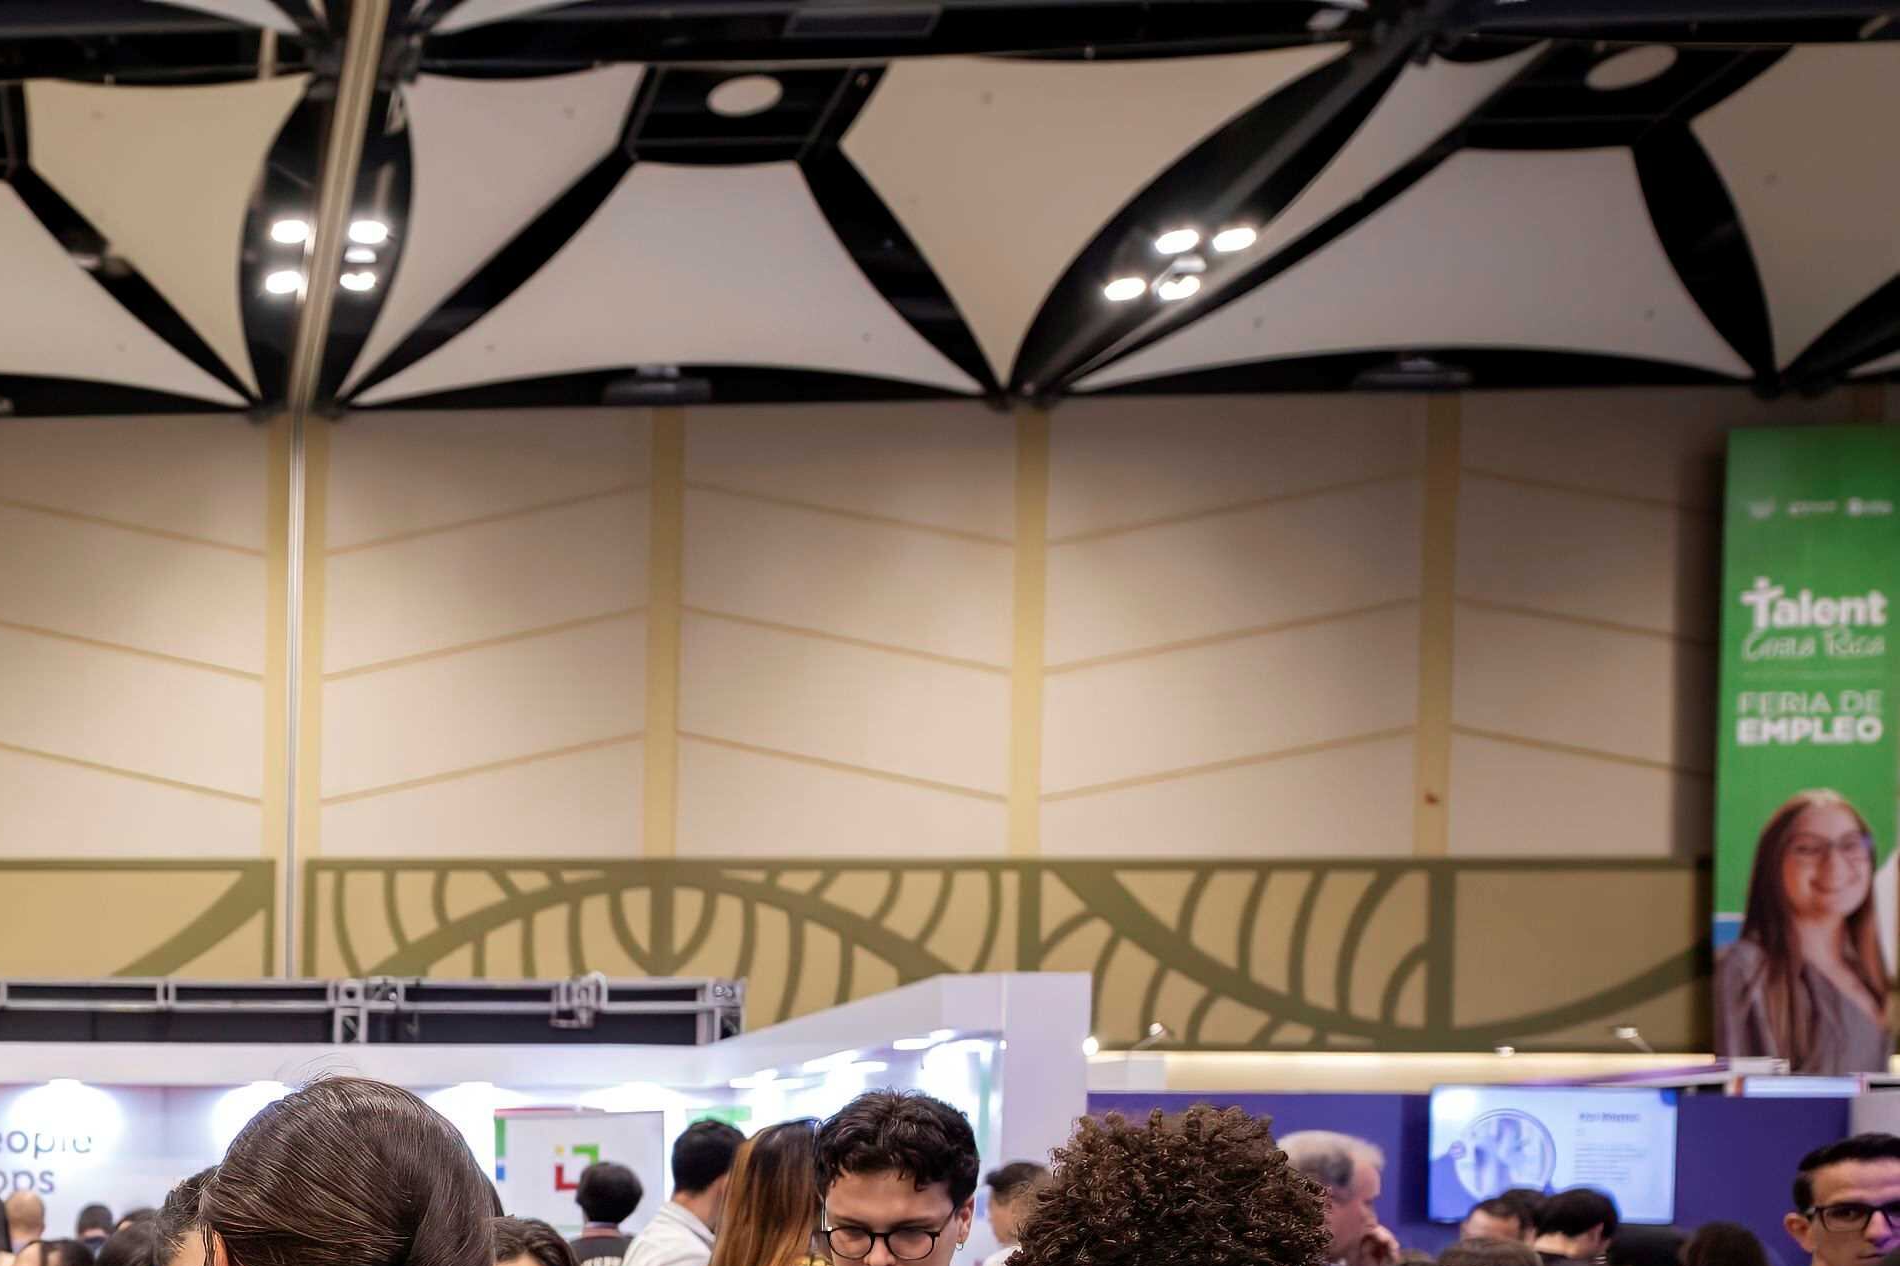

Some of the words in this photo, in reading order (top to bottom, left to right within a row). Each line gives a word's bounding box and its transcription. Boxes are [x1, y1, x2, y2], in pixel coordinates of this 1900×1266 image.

[1741, 577, 1887, 629] Talent
[1742, 630, 1816, 661] Costa
[1824, 627, 1885, 658] Rica
[1738, 691, 1832, 714] FERIA
[1840, 690, 1883, 713] DE
[1736, 717, 1883, 745] EMPLEO
